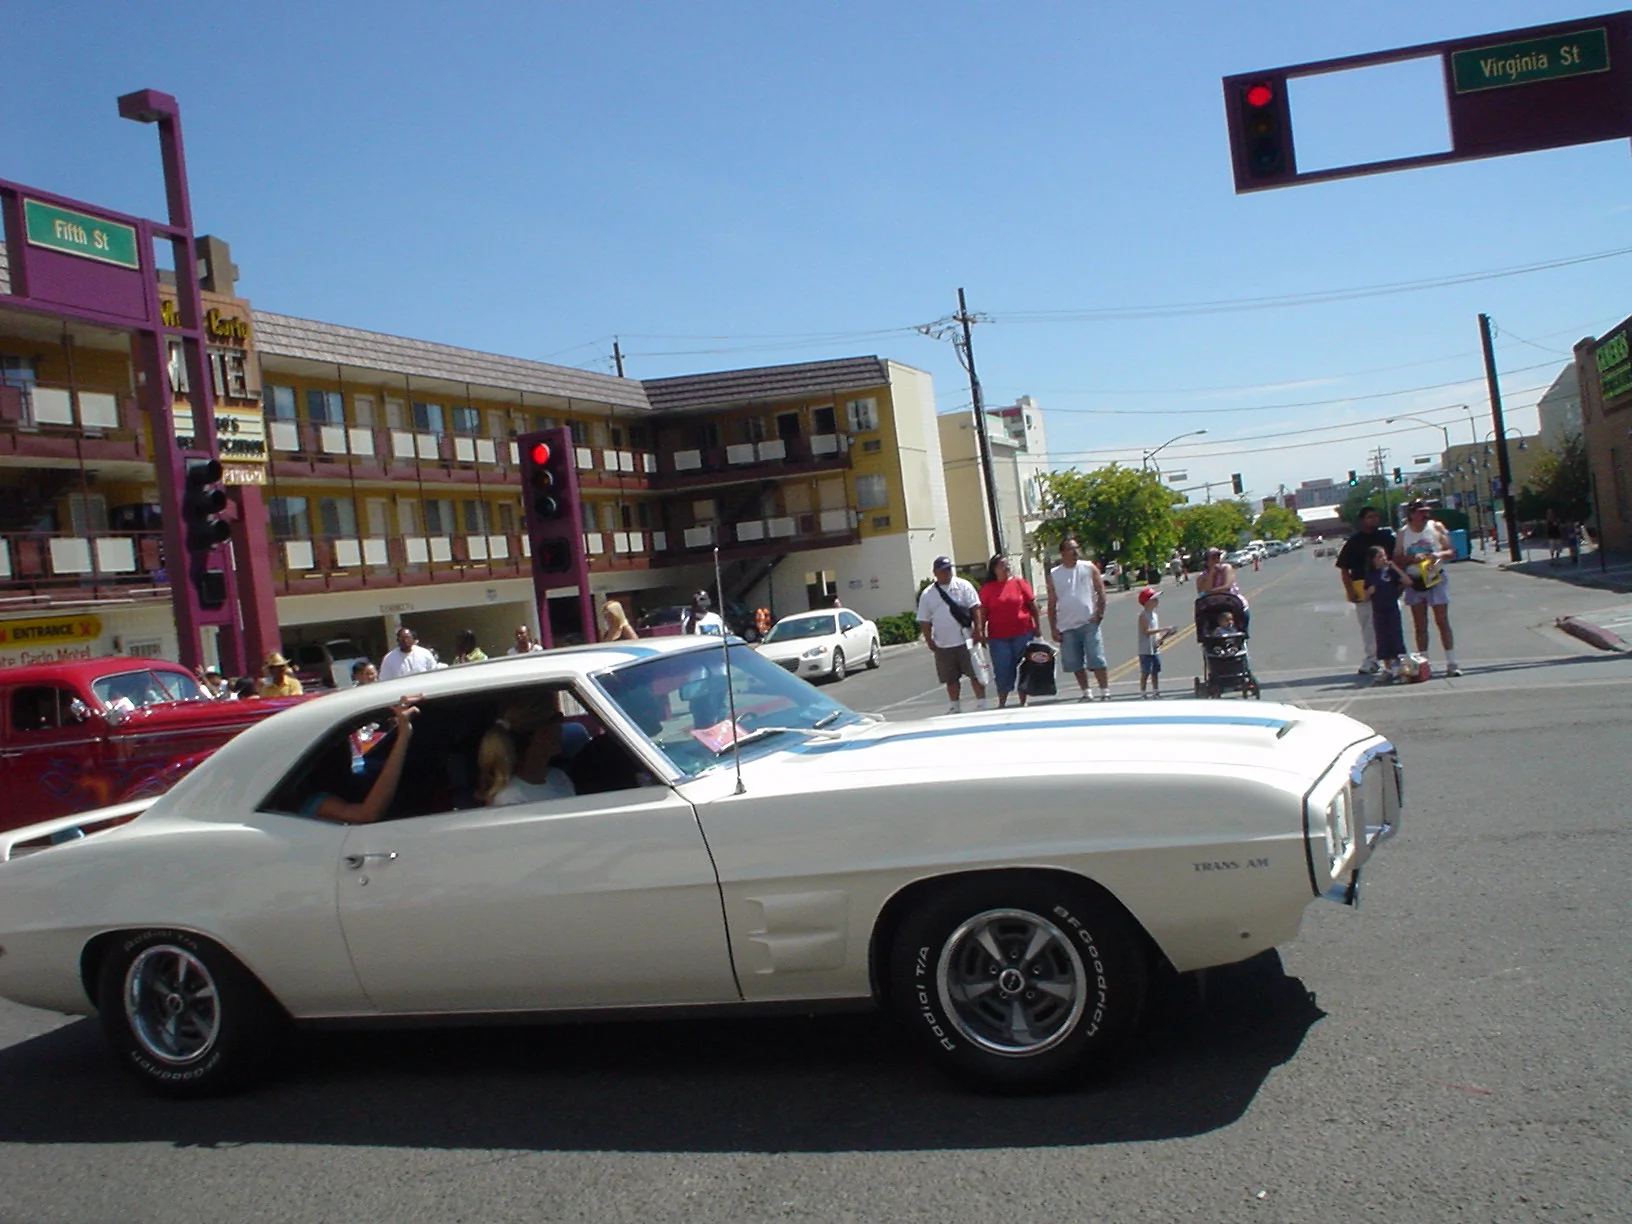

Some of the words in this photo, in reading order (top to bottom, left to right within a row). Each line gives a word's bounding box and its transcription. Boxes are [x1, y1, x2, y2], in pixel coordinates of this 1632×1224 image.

[1480, 51, 1549, 80] Virginia
[1560, 44, 1581, 65] St
[53, 219, 88, 245] Fifth
[93, 229, 109, 251] St
[164, 336, 262, 401] MTEL
[13, 623, 74, 639] ENTRANCE
[1246, 858, 1269, 869] AM
[916, 945, 931, 977] T/A
